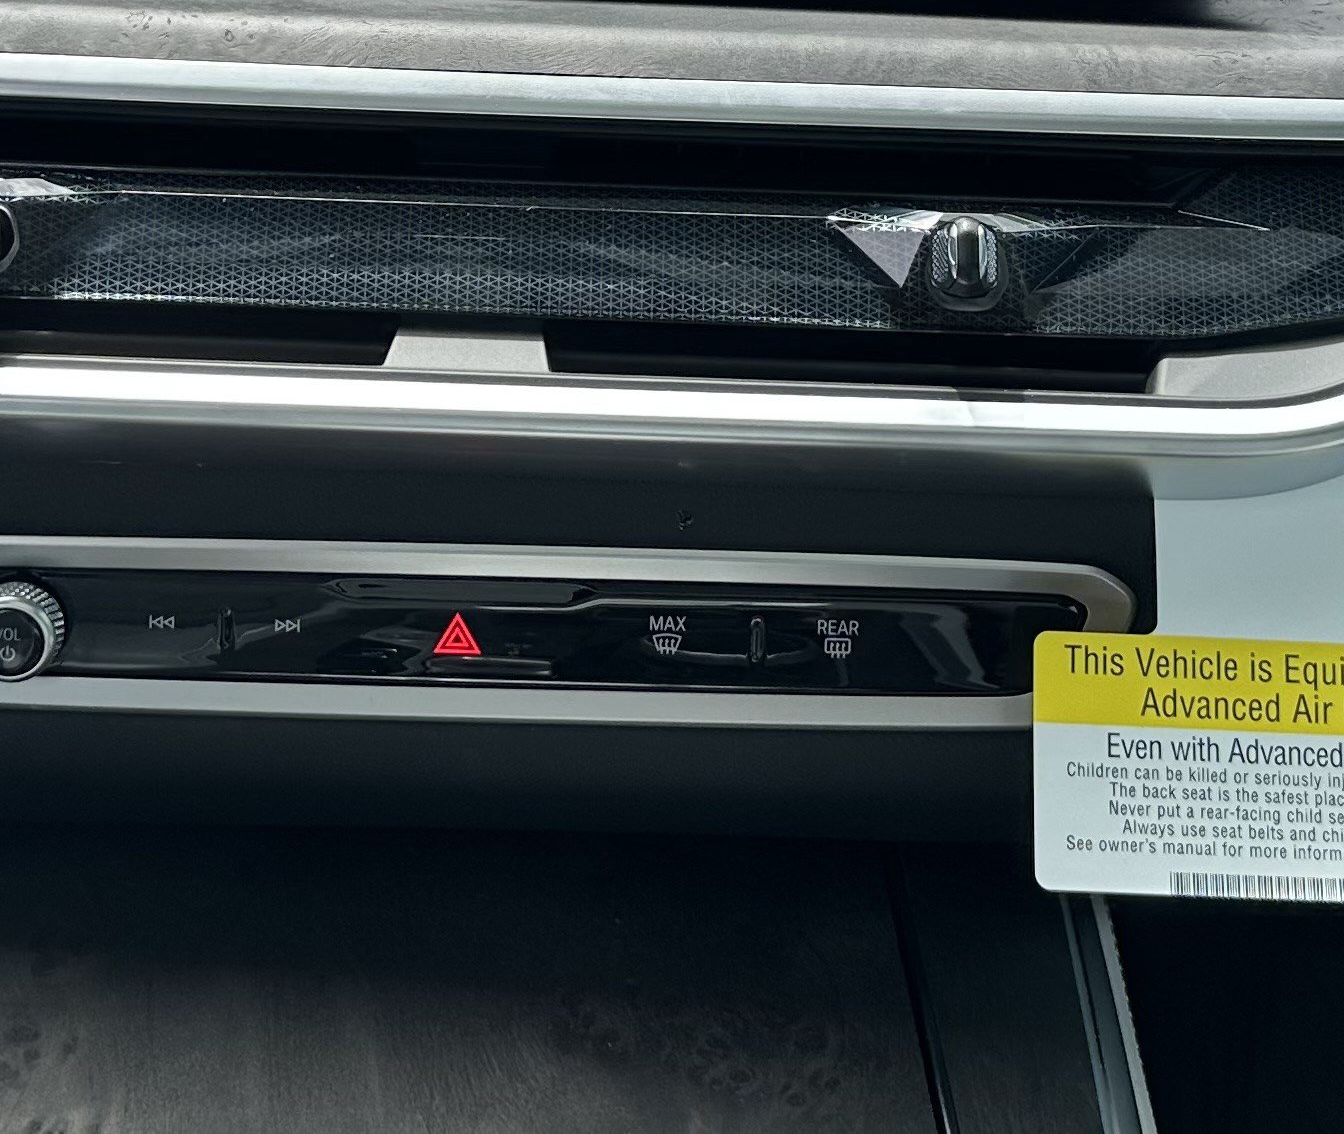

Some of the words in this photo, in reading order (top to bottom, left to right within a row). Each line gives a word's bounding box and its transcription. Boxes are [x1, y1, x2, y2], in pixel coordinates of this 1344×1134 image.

[649, 615, 686, 632] MAX
[817, 619, 859, 637] REAR
[1064, 644, 1124, 677] This
[1135, 647, 1238, 682] Vehicle
[1250, 651, 1273, 683] is
[1140, 687, 1281, 723] Advanced
[1292, 693, 1332, 725] Air
[1107, 733, 1163, 760] Even
[1171, 735, 1220, 762] with
[1228, 738, 1343, 768] Advanced
[1067, 761, 1128, 780] Children
[1134, 768, 1158, 781] can
[1166, 766, 1182, 781] be
[1188, 767, 1227, 783] killed
[1234, 771, 1249, 784] or
[1255, 770, 1322, 790] seriously
[1109, 782, 1136, 798] The
[1142, 783, 1176, 799] back
[1182, 786, 1213, 801] seat
[1218, 787, 1230, 802] is
[1236, 787, 1259, 803] the
[1264, 789, 1309, 805] safest
[1109, 800, 1151, 816] Never
[1157, 803, 1182, 820] put
[1186, 806, 1194, 818] a
[1200, 804, 1281, 825] rear-facing
[1287, 808, 1322, 824] child
[1123, 819, 1175, 838] Always
[1181, 824, 1206, 837] use
[1212, 823, 1243, 839] seat
[1249, 824, 1284, 841] belts
[1290, 826, 1316, 842] and
[1066, 835, 1093, 851] See
[1099, 838, 1156, 854] owner's
[1163, 840, 1217, 856] manual
[1222, 841, 1243, 857] for
[1249, 844, 1287, 859] more
